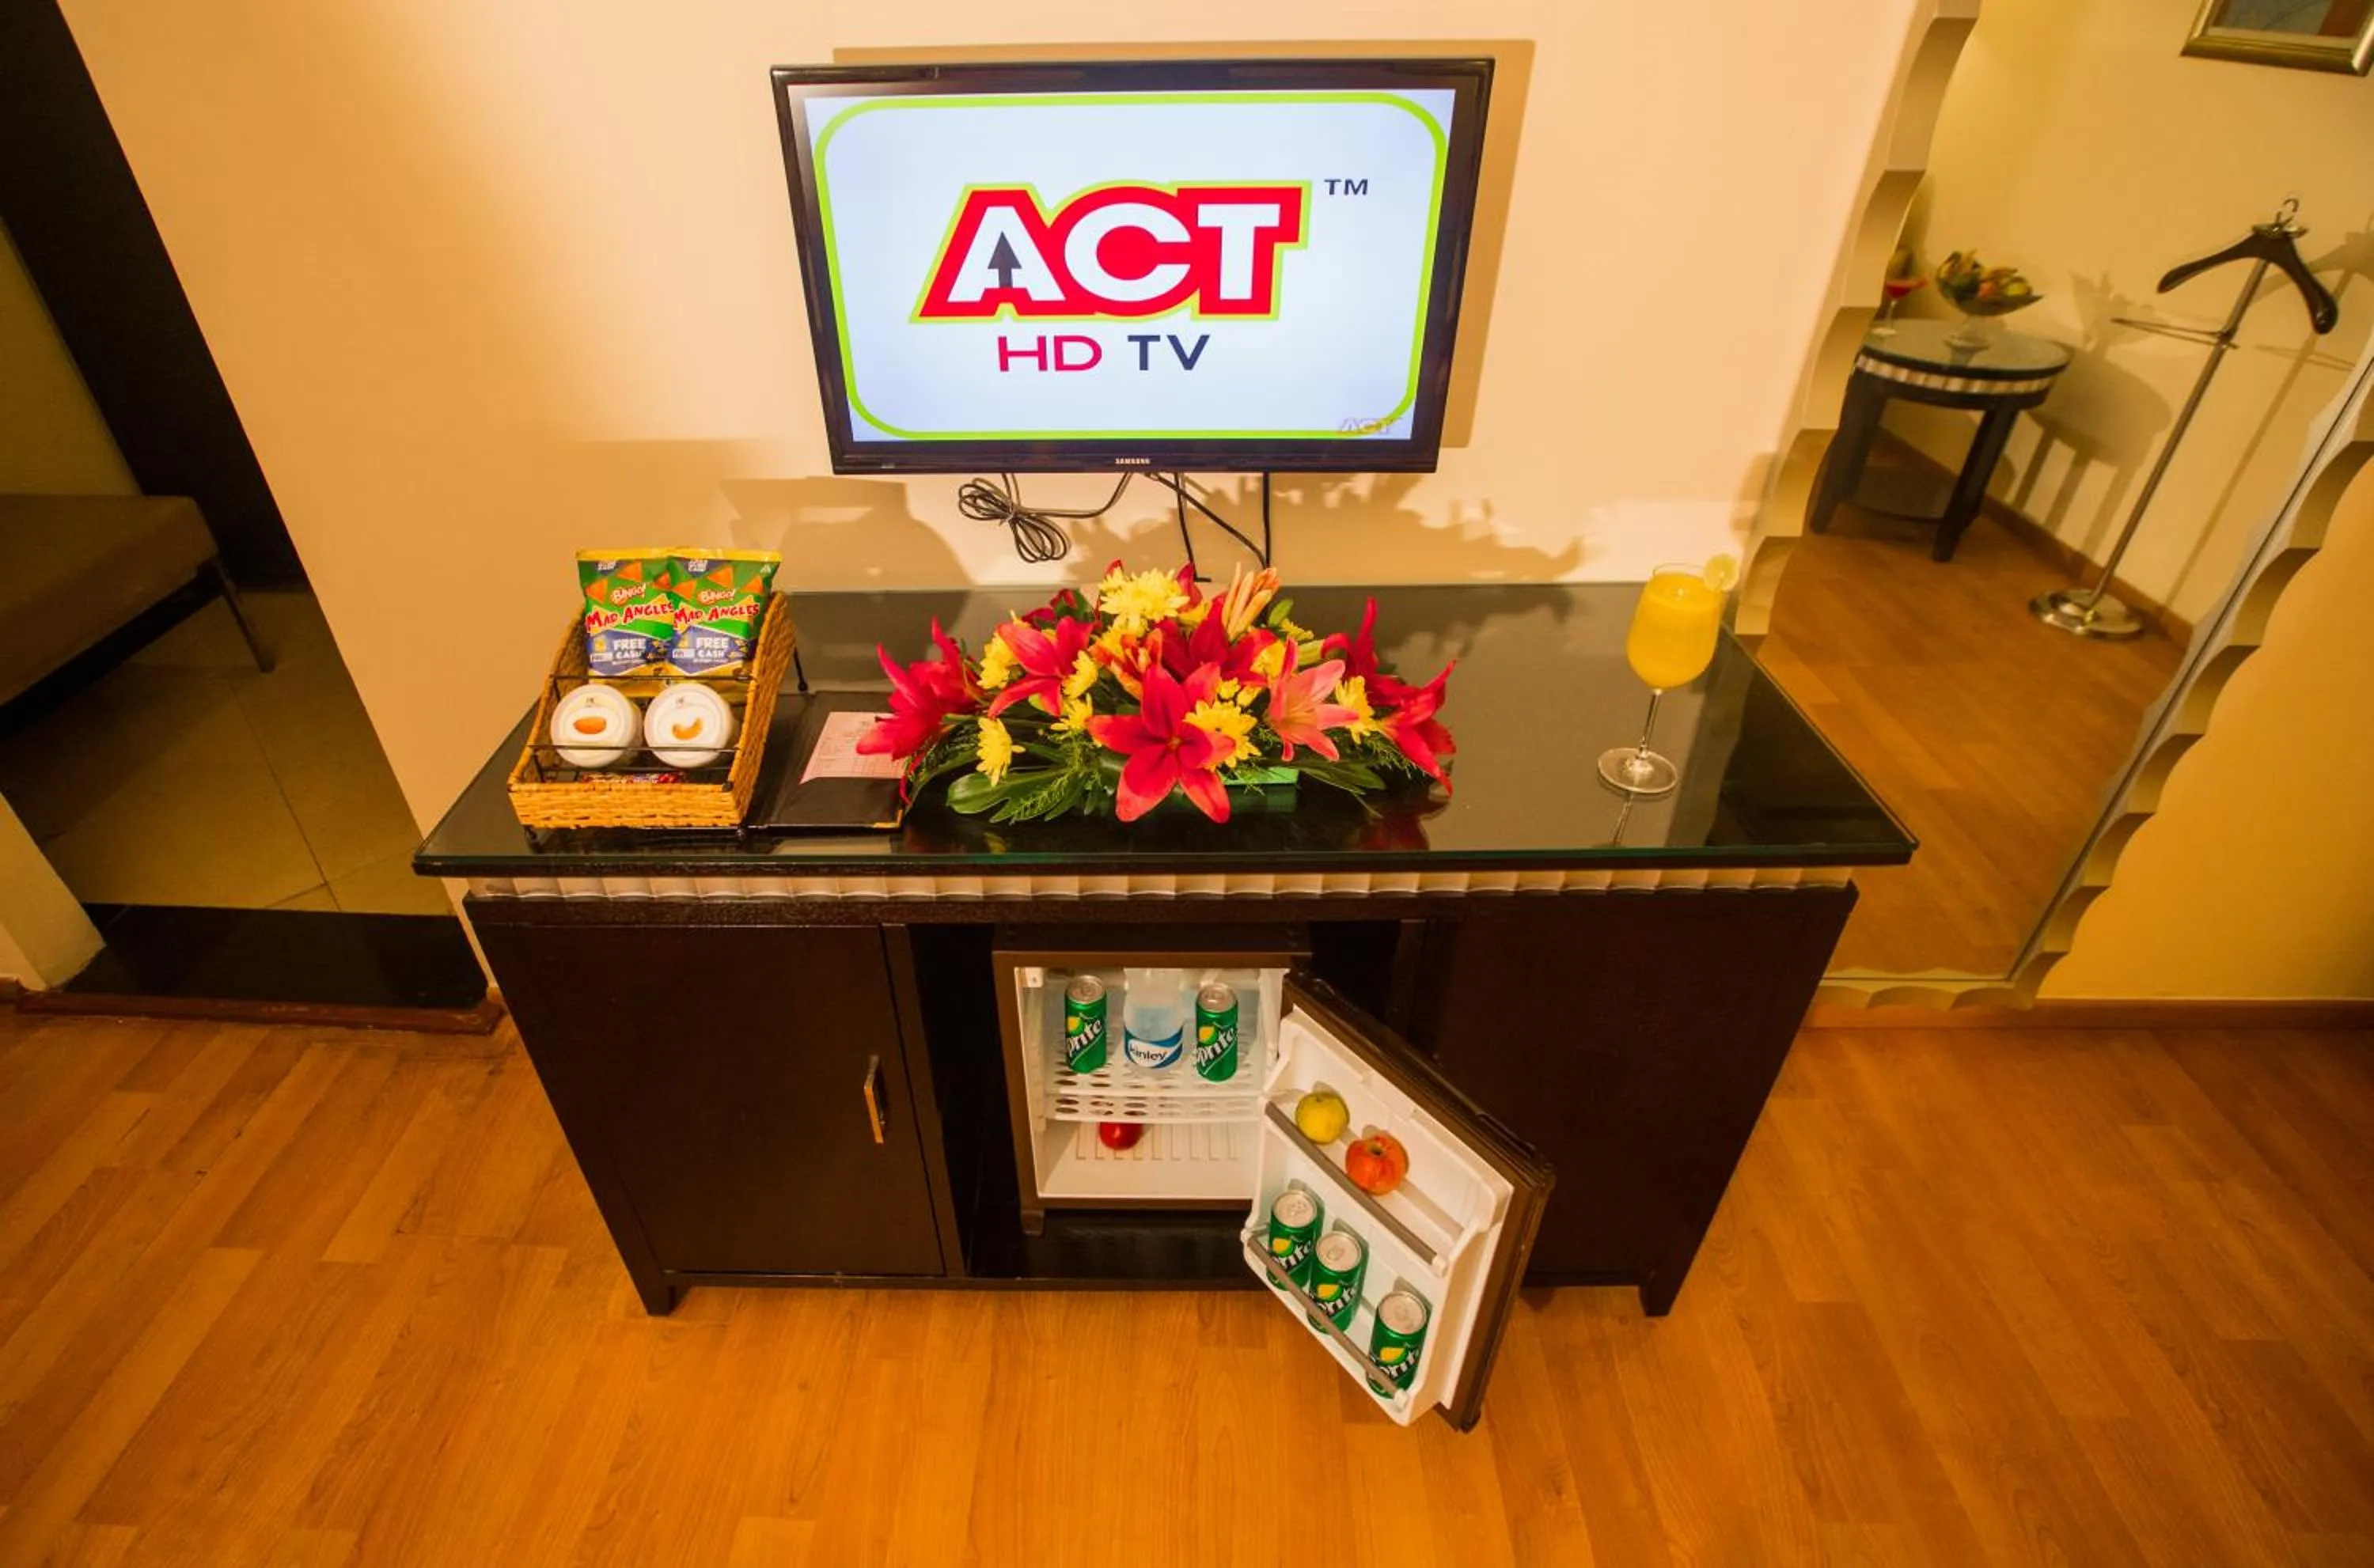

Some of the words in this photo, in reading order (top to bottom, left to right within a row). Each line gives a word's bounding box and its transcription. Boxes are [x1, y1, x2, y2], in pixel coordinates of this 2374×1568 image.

[1324, 179, 1369, 196] TM
[935, 195, 1291, 309] ACT
[998, 335, 1103, 372] HD
[1128, 335, 1211, 372] TV
[613, 638, 647, 650] FREE
[696, 637, 729, 649] FREE
